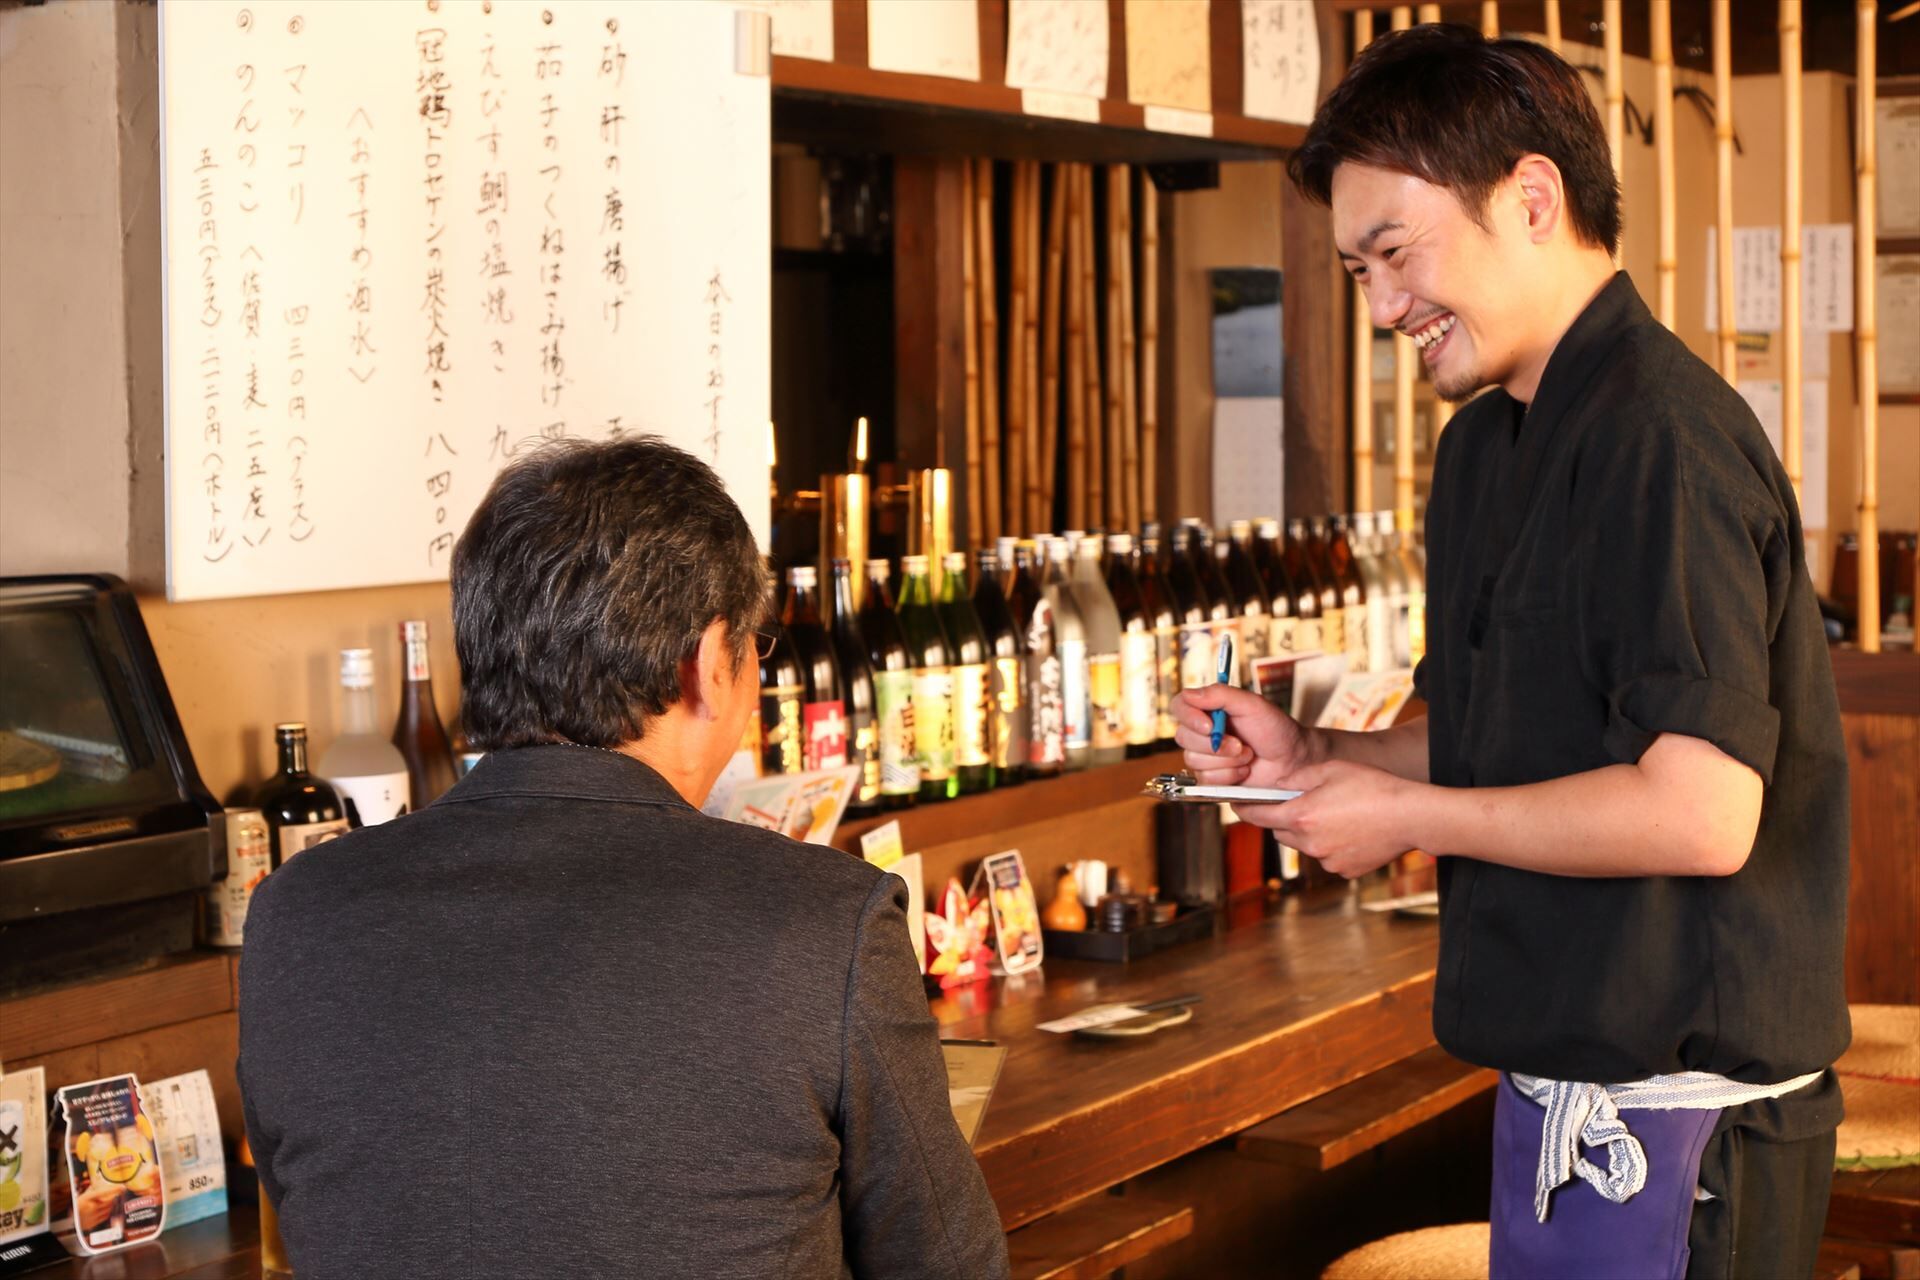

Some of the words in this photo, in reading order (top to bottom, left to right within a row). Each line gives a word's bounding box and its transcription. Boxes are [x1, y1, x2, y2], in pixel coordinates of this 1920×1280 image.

[234, 63, 261, 213] のんのこ
[284, 64, 307, 225] マッコリ
[476, 33, 514, 373] えびす鯛の塩焼き
[534, 41, 575, 408] 茄子のつくねはさみ揚げ
[598, 43, 633, 334] 砂肝の唐揚げ
[0, 1245, 32, 1261] KIRIN
